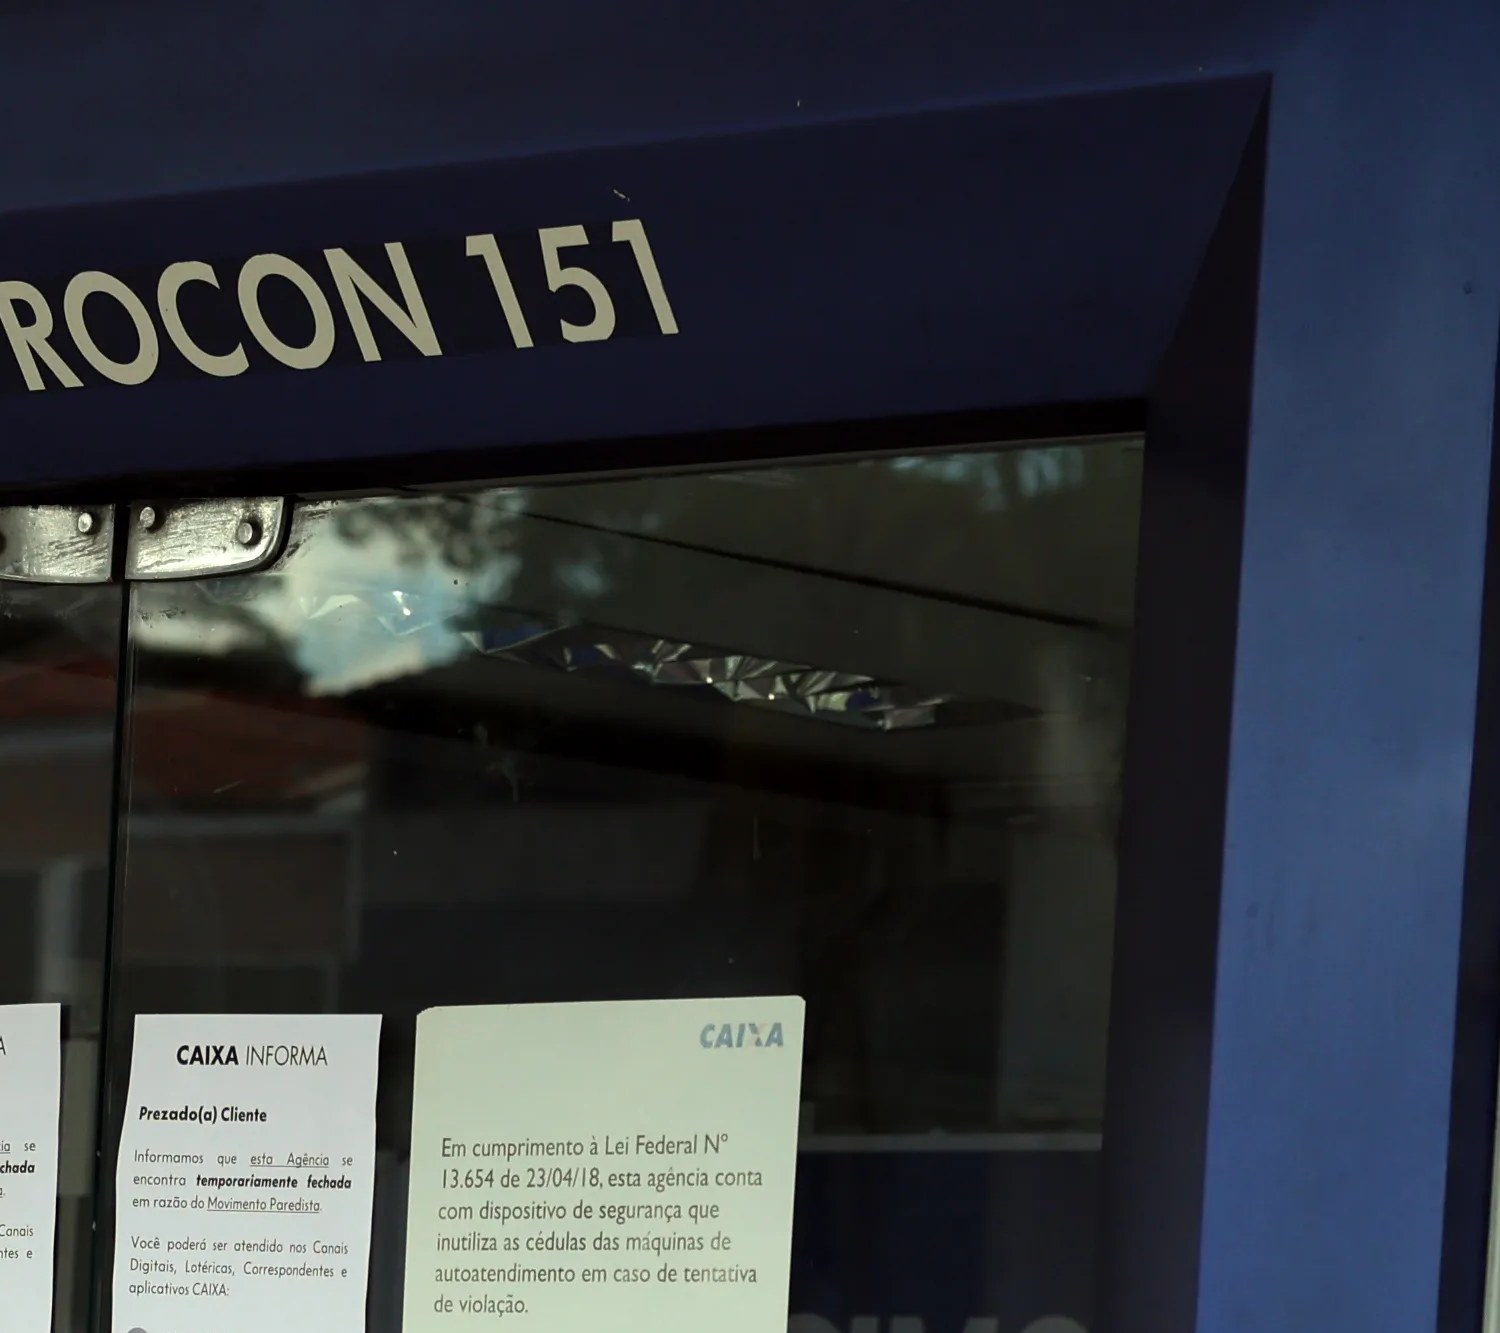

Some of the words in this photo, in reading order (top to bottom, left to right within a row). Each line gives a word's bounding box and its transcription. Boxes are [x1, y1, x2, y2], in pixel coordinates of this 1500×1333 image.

[466, 223, 678, 348] 151
[700, 1023, 783, 1048] CAIXA
[177, 1045, 238, 1065] CAIXA
[247, 1046, 327, 1065] INFORMA
[139, 1106, 217, 1124] Prezado(a)
[221, 1107, 266, 1121] Cliente
[442, 1138, 465, 1157] Em
[473, 1141, 583, 1162] cumprimento
[590, 1136, 598, 1155] à
[606, 1136, 628, 1155] Lei
[636, 1134, 697, 1154] Federal
[443, 1169, 494, 1188] 13.654
[501, 1169, 520, 1188] de
[527, 1167, 603, 1188] 23/04/18,
[608, 1173, 641, 1187] esta
[648, 1167, 708, 1192] agência
[716, 1172, 762, 1186] conta
[439, 1207, 472, 1219] com
[480, 1201, 566, 1225] dispositivo
[573, 1200, 592, 1219] de
[599, 1205, 681, 1225] segurança
[689, 1205, 719, 1224] que
[438, 1232, 497, 1250] inutiliza
[504, 1238, 519, 1250] as
[526, 1231, 586, 1250] cédulas
[593, 1231, 619, 1250] das
[627, 1232, 703, 1256] máquinas
[711, 1231, 730, 1250] de
[436, 1263, 575, 1282] autoatendimento
[582, 1269, 606, 1282] em
[614, 1269, 650, 1282] caso
[657, 1263, 677, 1282] de
[684, 1268, 756, 1282] tentativa
[434, 1295, 453, 1312] de
[460, 1295, 528, 1317] violação.
